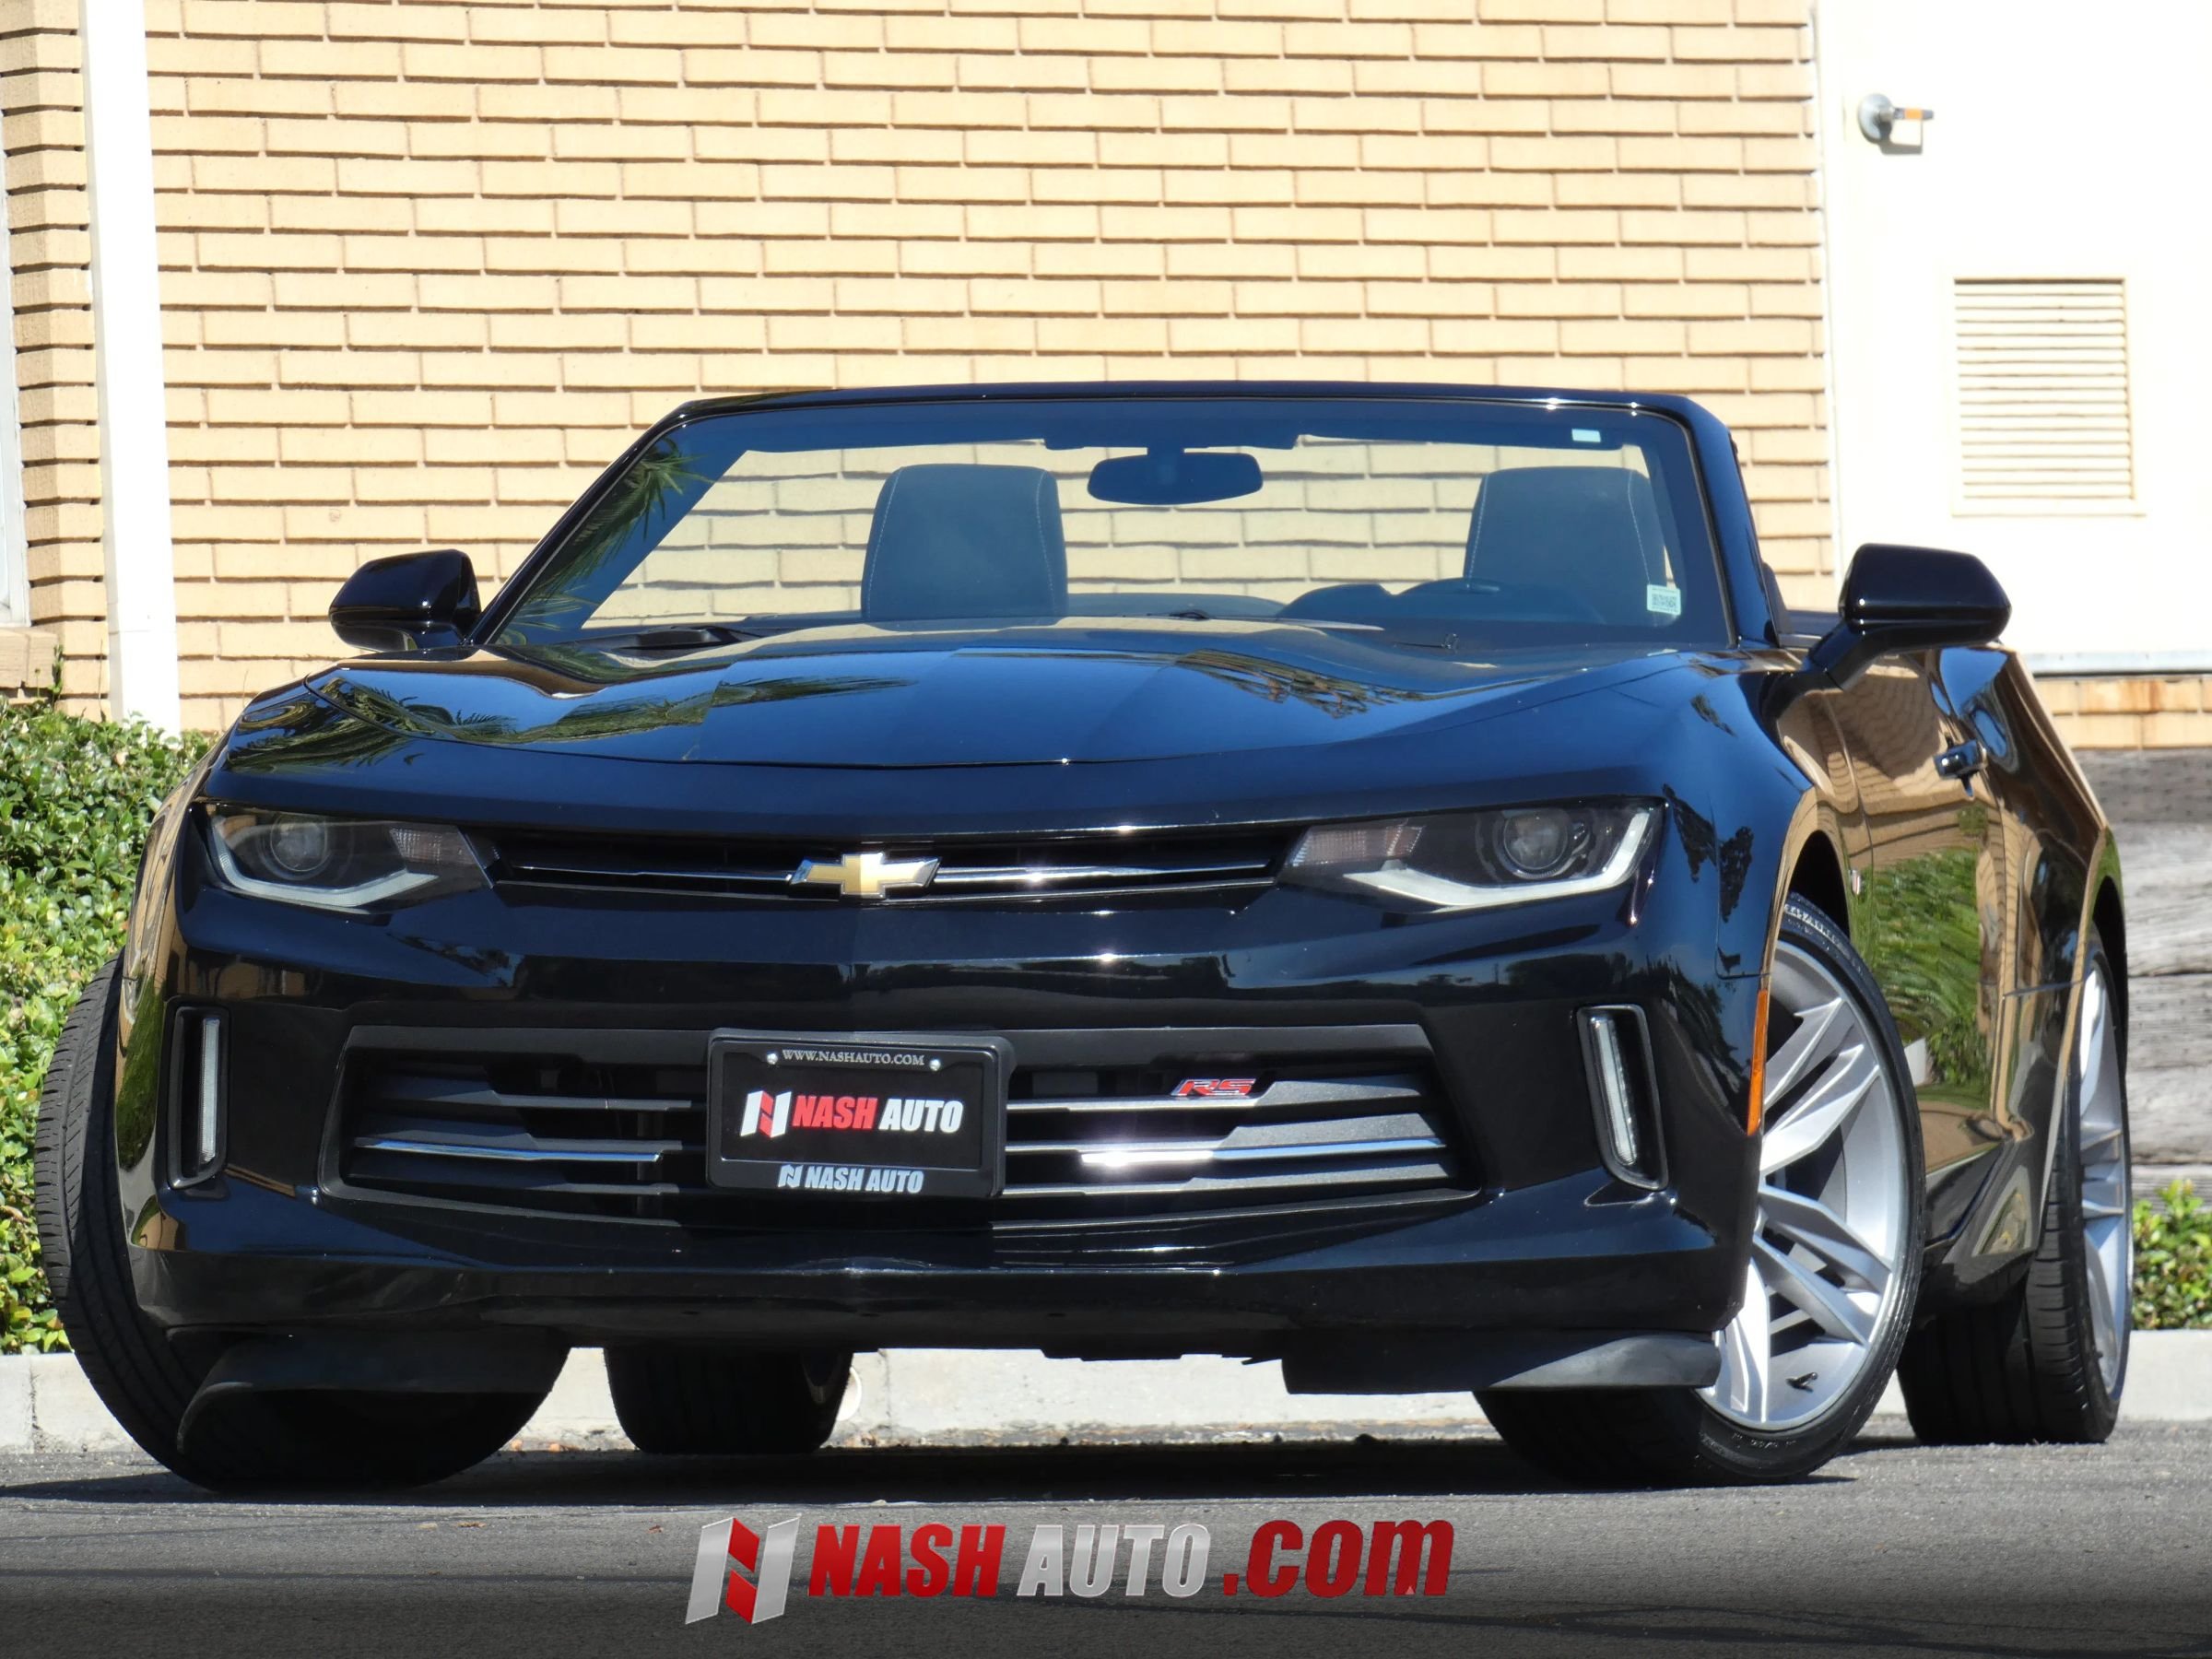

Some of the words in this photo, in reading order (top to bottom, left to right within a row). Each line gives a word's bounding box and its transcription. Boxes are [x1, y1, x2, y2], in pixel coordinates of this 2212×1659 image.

[782, 1049, 925, 1066] WWW.NASHAUTO.COM
[1171, 1078, 1256, 1096] RS
[792, 1095, 878, 1131] NASH
[878, 1098, 964, 1133] AUTO
[805, 1165, 865, 1192] NASH
[865, 1168, 924, 1194] AUTO
